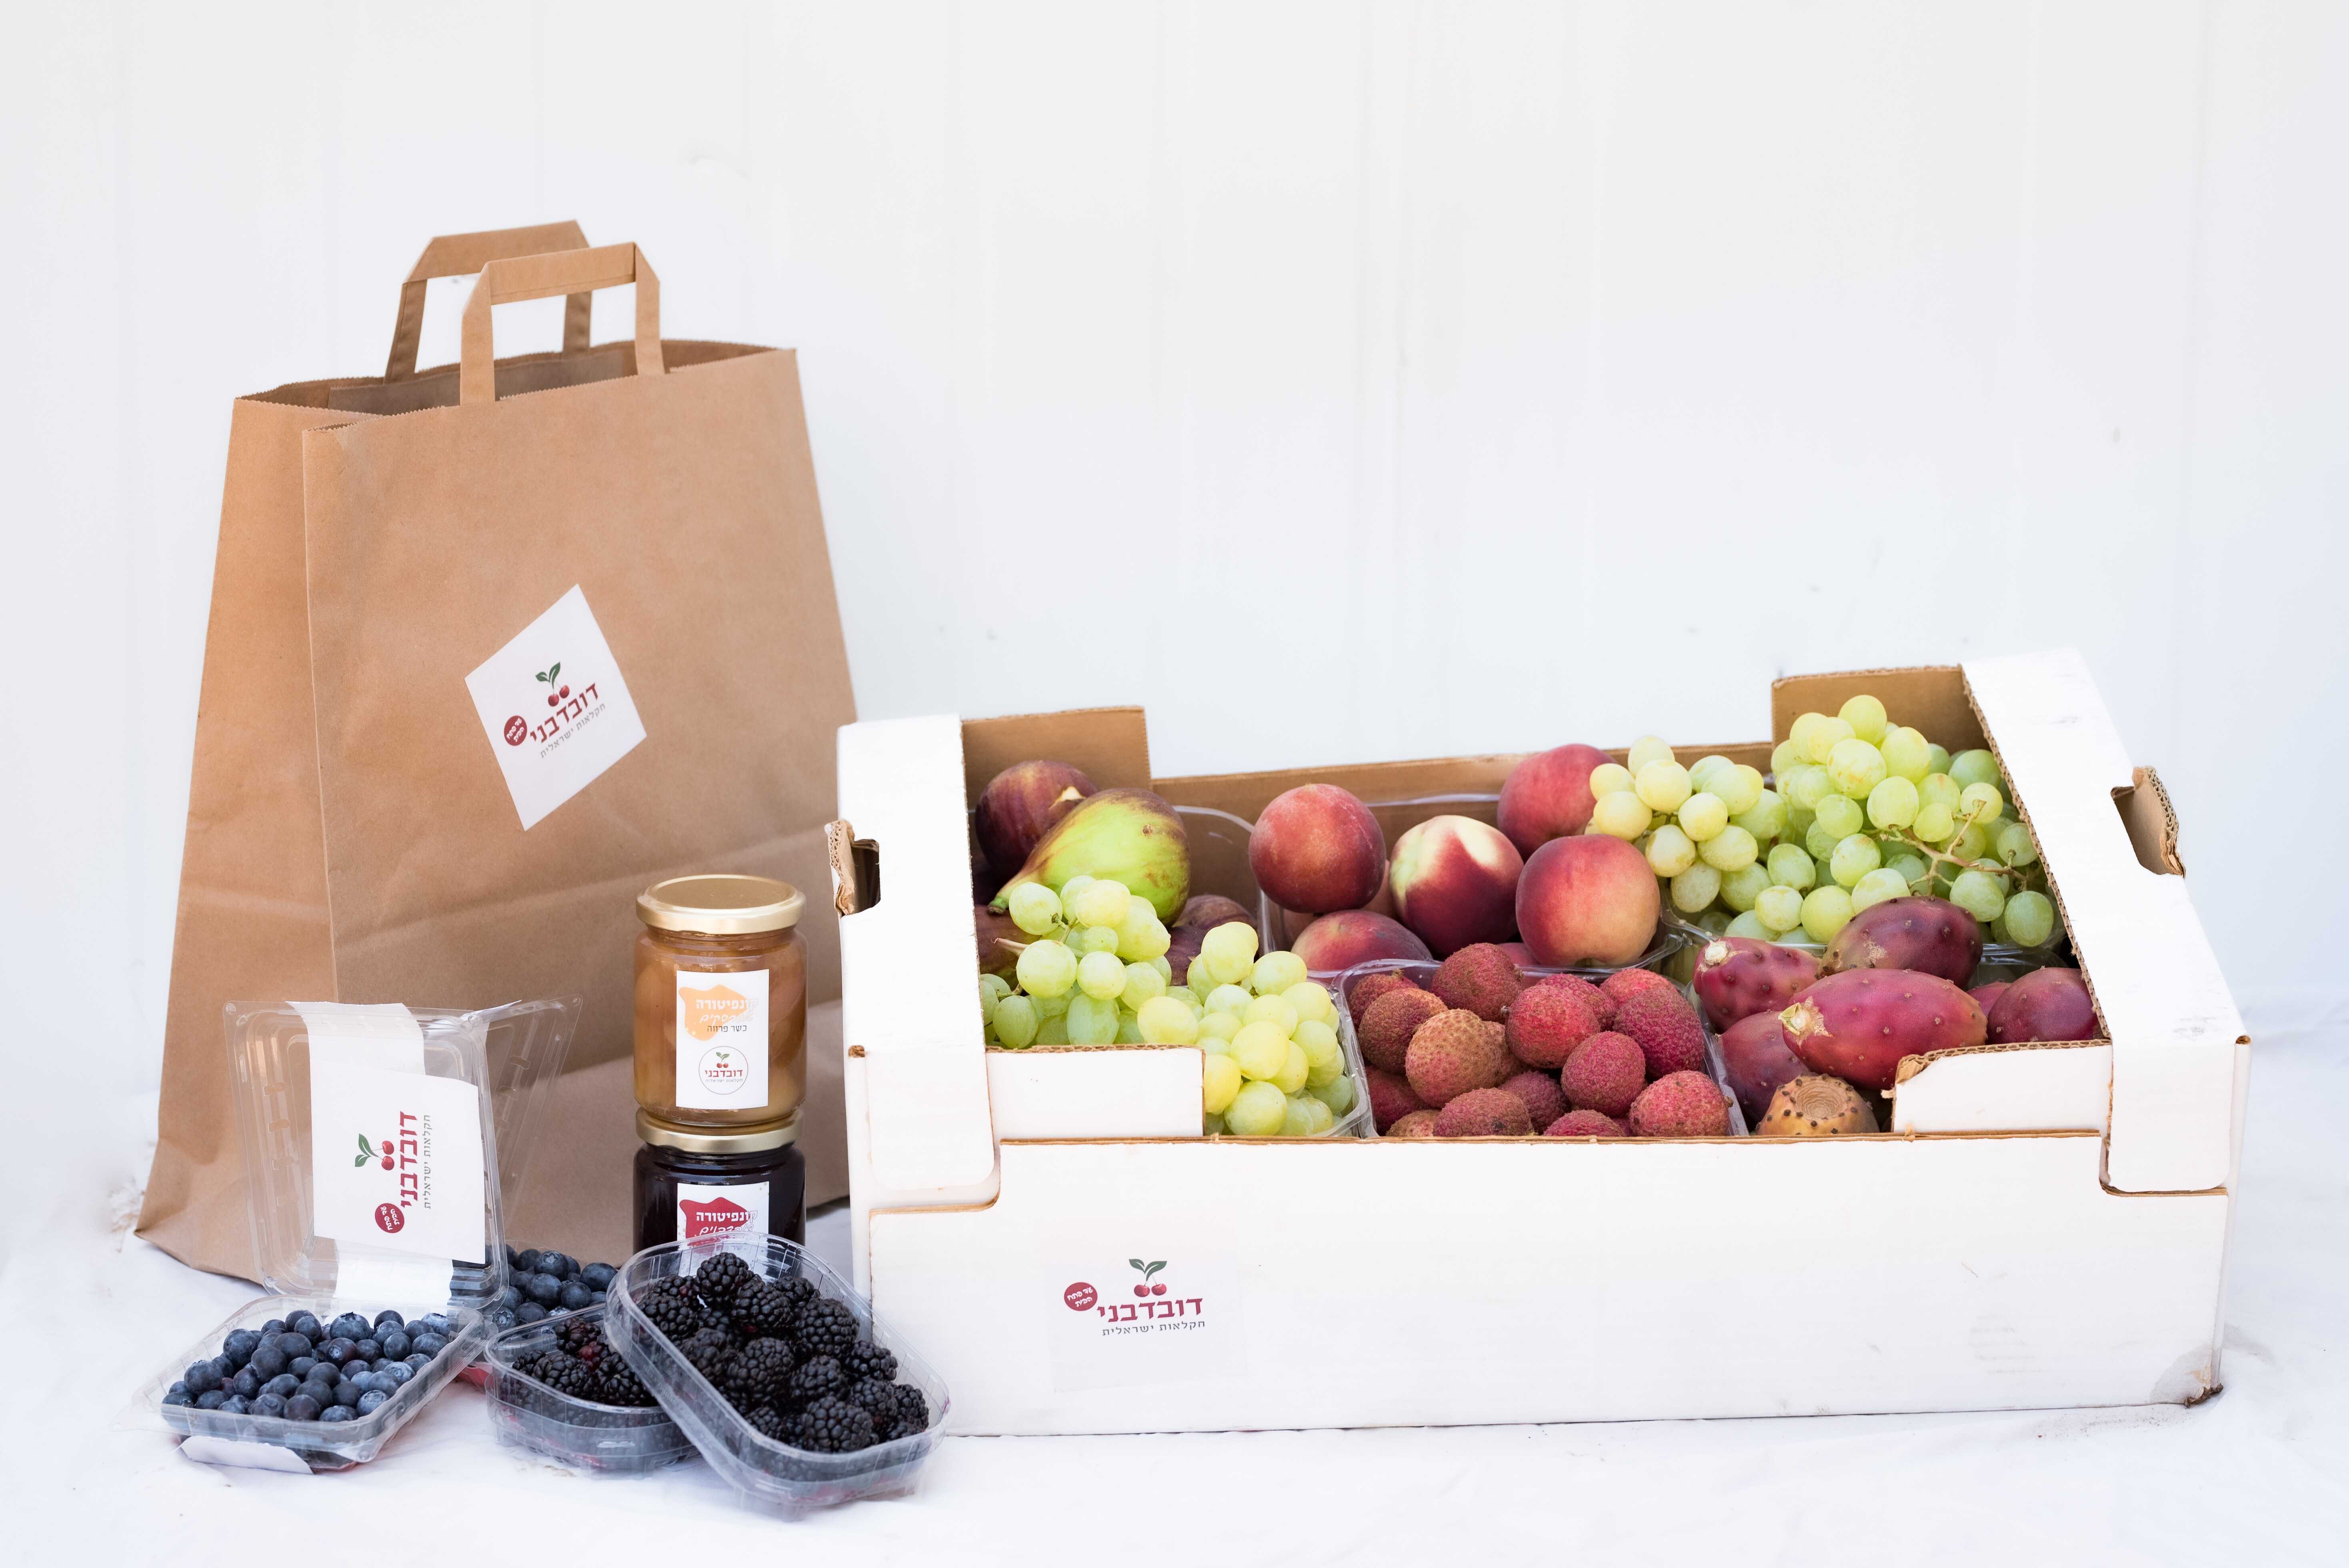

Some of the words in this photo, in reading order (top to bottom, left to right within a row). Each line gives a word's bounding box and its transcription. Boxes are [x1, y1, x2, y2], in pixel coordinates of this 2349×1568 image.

[530, 683, 598, 743] דובדבני
[576, 703, 606, 730] חקלאות
[540, 728, 574, 758] ישראלית
[696, 998, 758, 1011] קונפיטורה
[422, 1115, 432, 1157] חקלאות
[400, 1111, 418, 1208] דובדבני
[423, 1162, 431, 1209] ישראלית
[381, 1206, 387, 1216] עד
[384, 1216, 393, 1231] פתח
[390, 1208, 400, 1226] הבית
[696, 1210, 758, 1223] קונפיטורה
[1067, 1292, 1083, 1301] פתח
[1075, 1296, 1093, 1308] הבית
[1097, 1298, 1203, 1322] דובדבני
[1102, 1325, 1154, 1336] ישראלית
[1159, 1321, 1205, 1331] חקלאות
